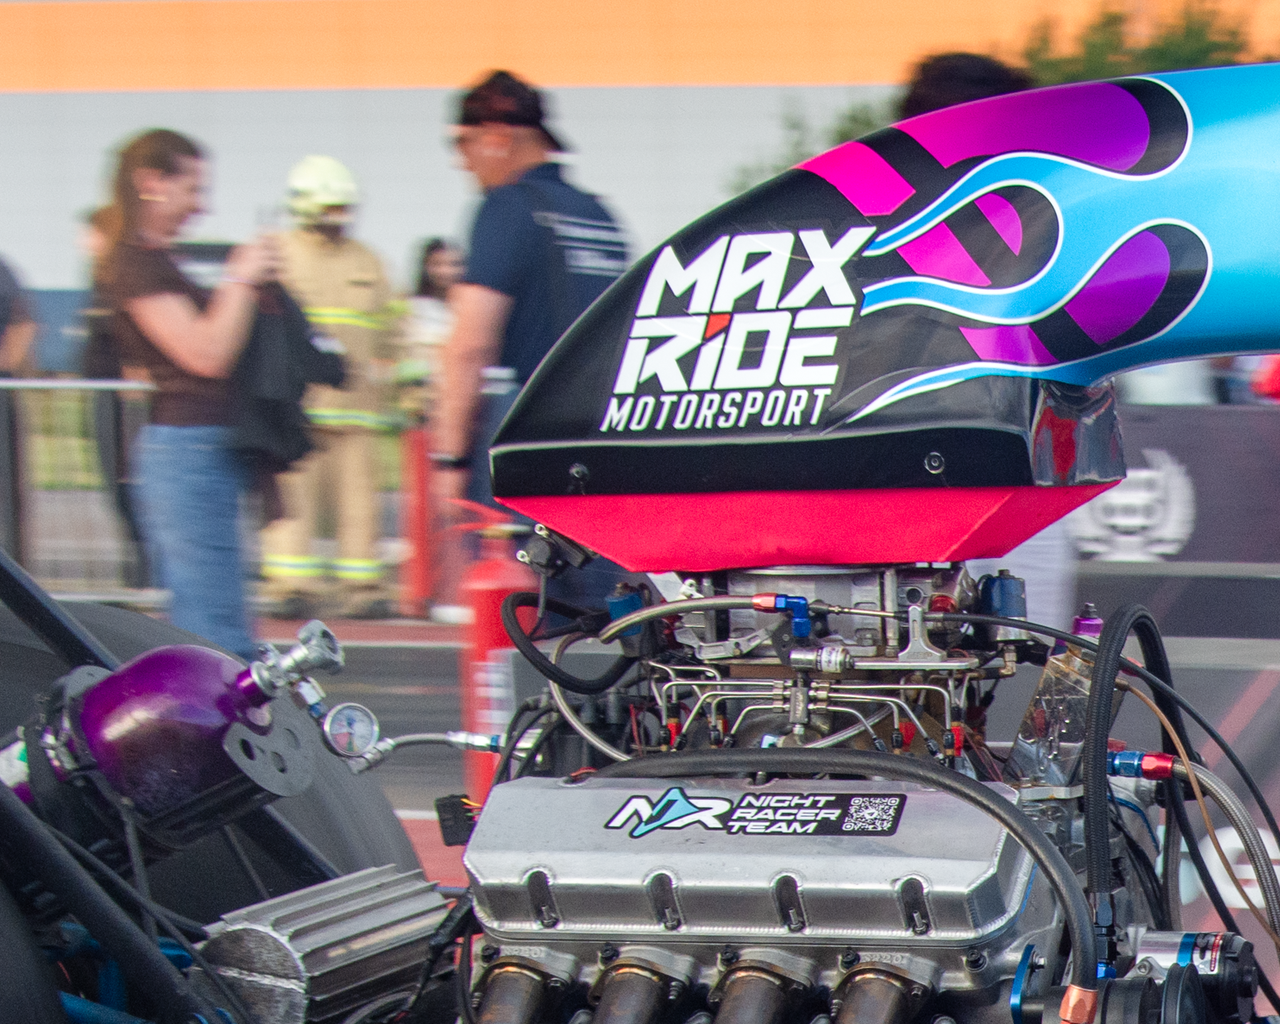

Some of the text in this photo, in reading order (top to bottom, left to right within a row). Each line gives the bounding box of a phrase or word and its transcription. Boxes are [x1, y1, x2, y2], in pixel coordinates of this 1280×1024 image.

[634, 225, 878, 318] MAX
[599, 388, 832, 432] MOTORSPORT
[740, 795, 836, 807] NIGHT
[731, 808, 841, 821] RACER
[727, 821, 818, 834] TEAM
